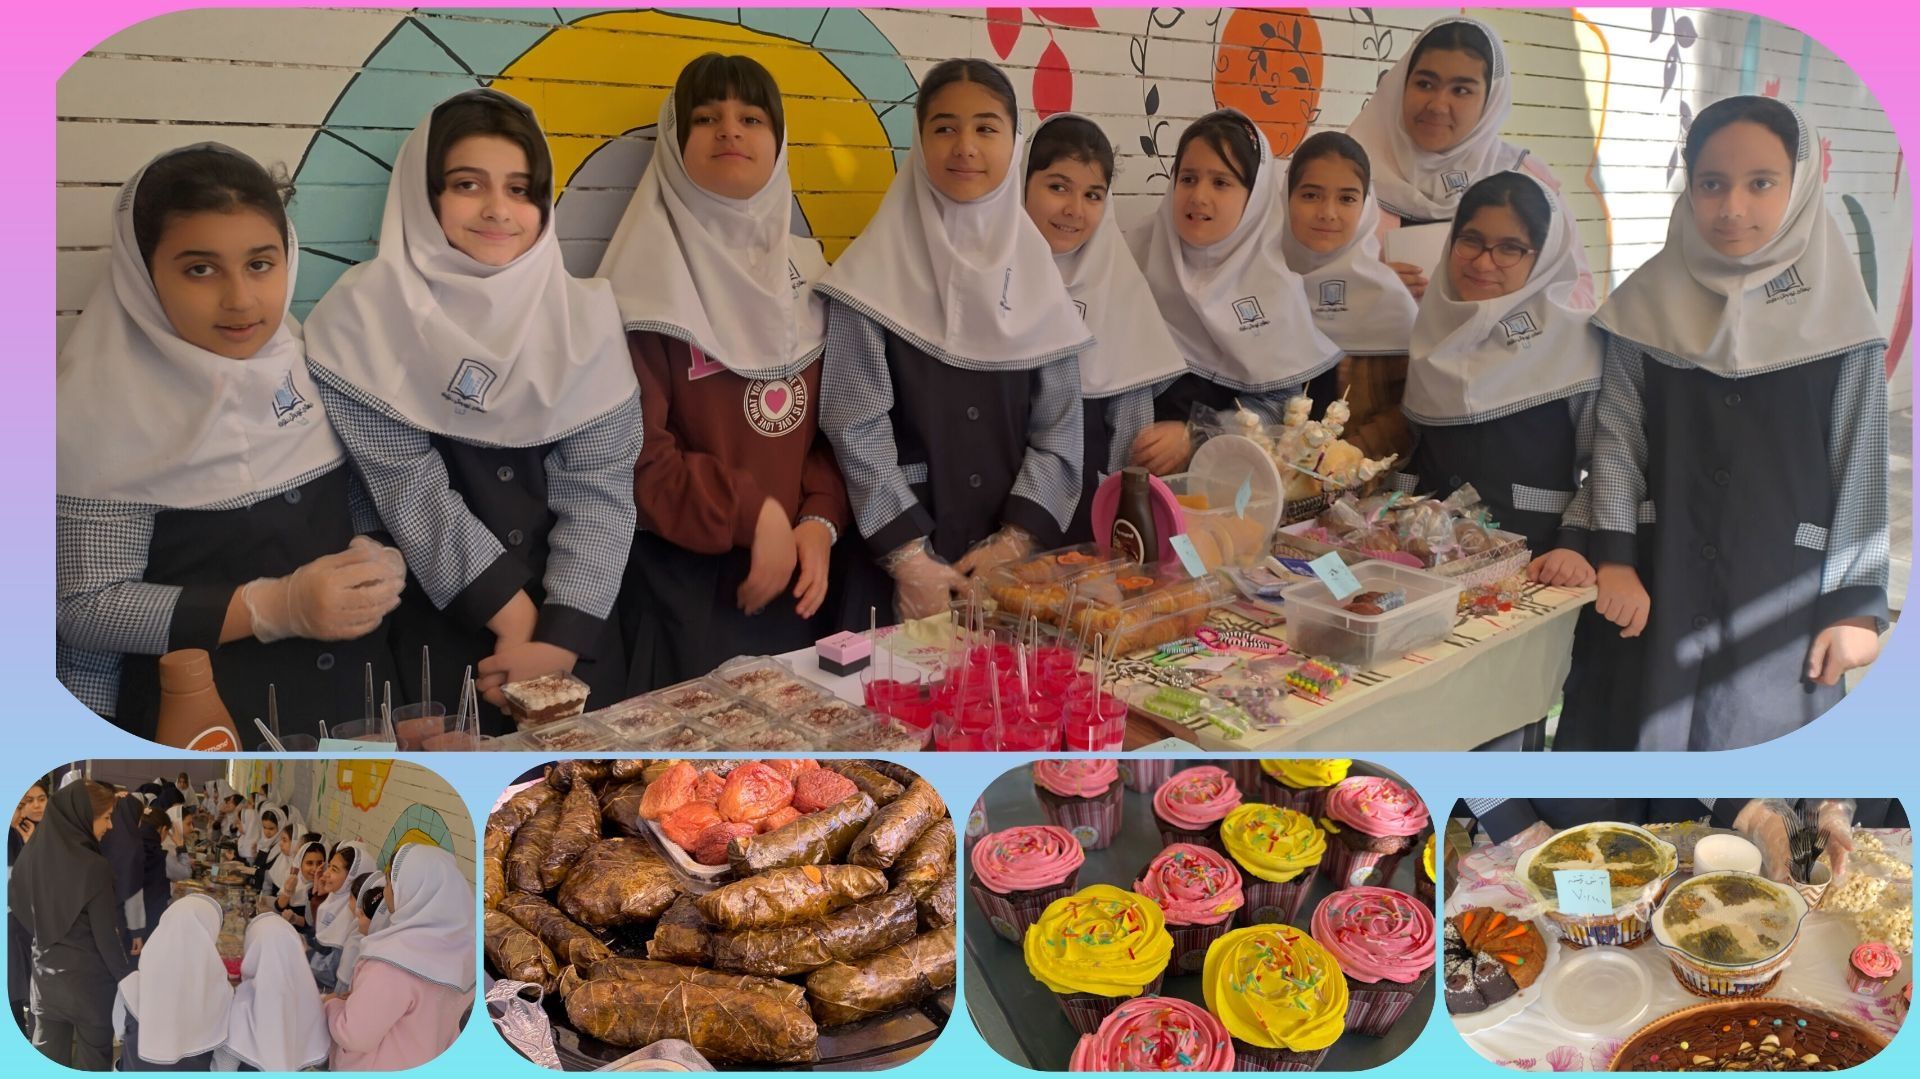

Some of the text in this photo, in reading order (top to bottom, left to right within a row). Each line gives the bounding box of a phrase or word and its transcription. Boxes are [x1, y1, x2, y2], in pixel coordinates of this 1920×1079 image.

[751, 380, 763, 396] YOU
[793, 384, 804, 405] NEED
[749, 399, 761, 421] WHAT
[792, 406, 802, 416] IS
[757, 417, 775, 431] LOVE
